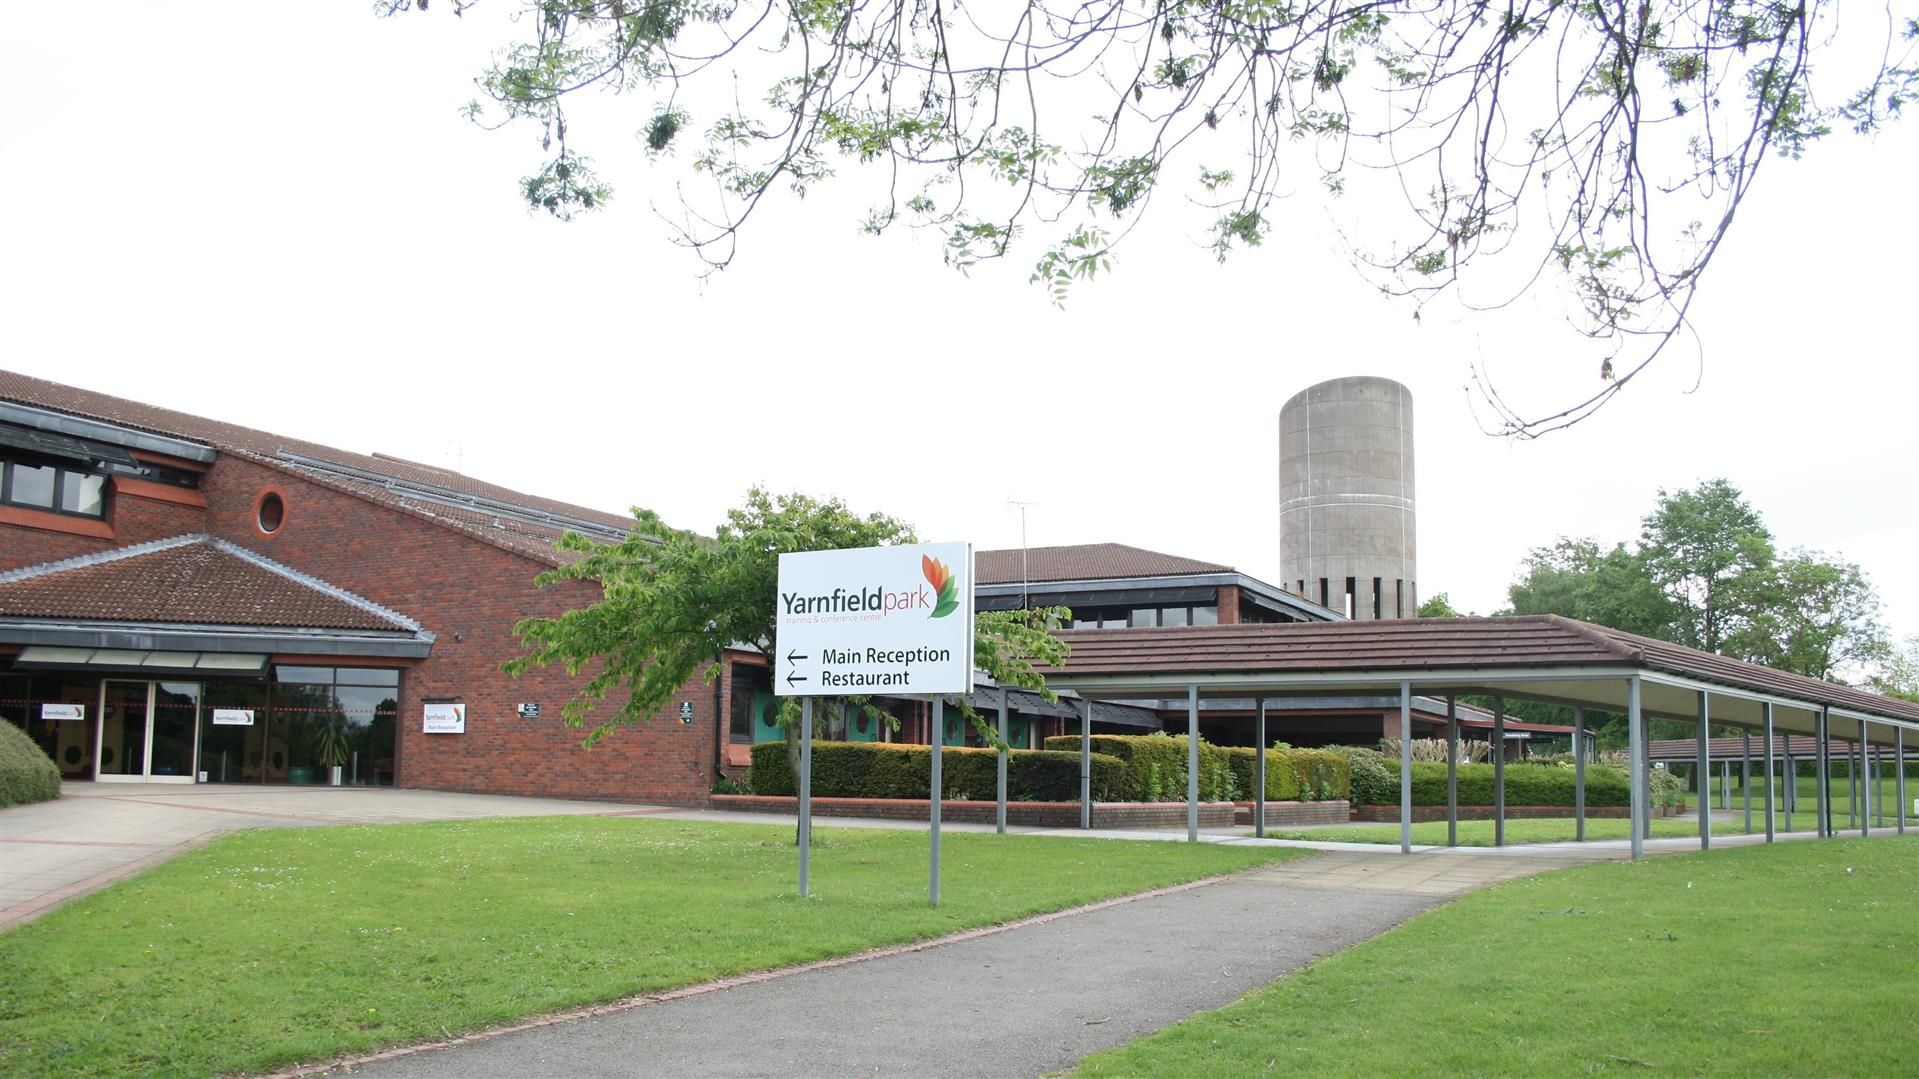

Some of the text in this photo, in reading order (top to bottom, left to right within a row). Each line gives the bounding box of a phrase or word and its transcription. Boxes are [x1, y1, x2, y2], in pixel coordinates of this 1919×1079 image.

[787, 617, 812, 625] training
[821, 614, 858, 623] conference
[860, 614, 881, 622] centre
[822, 646, 950, 666] Main Reception
[822, 670, 910, 686] Restaurant
